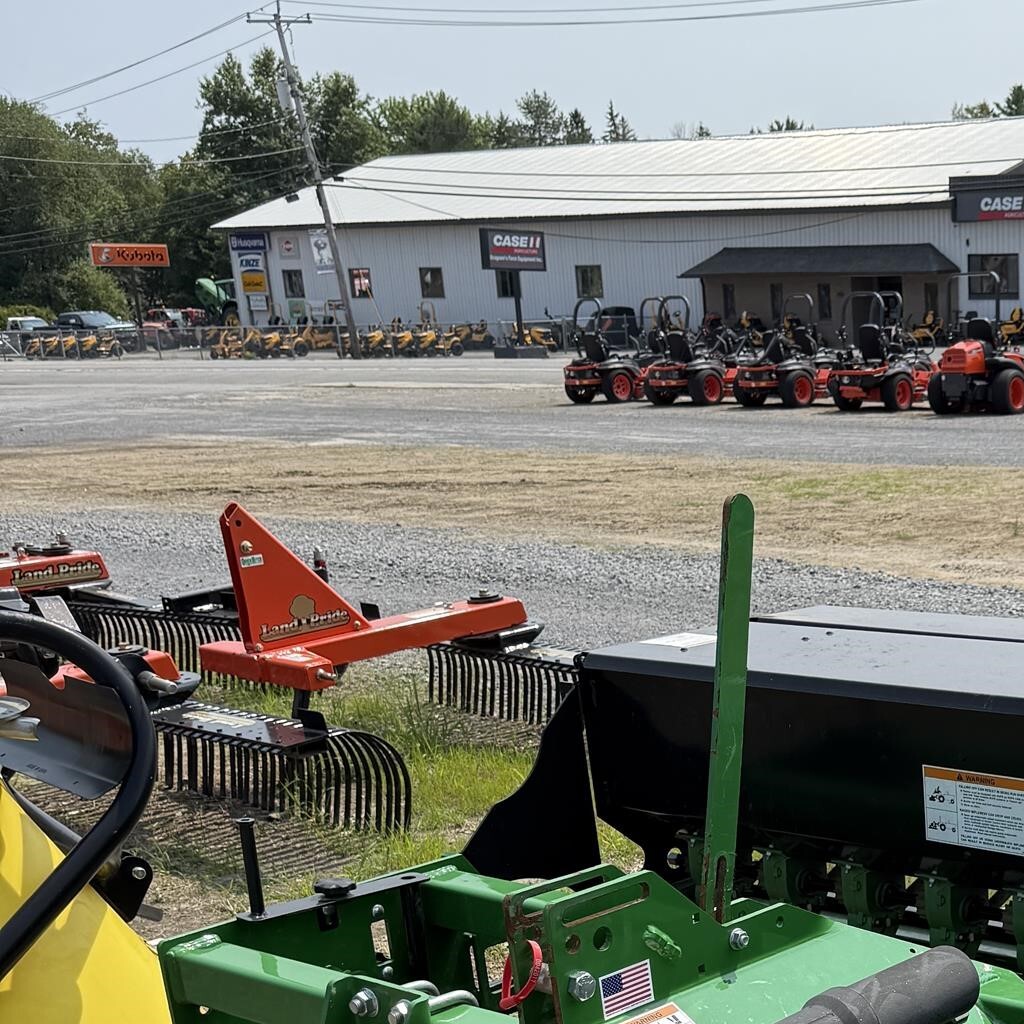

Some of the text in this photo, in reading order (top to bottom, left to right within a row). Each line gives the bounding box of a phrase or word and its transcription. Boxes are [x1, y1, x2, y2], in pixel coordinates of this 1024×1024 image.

[980, 196, 1023, 211] CASE
[493, 234, 528, 247] CASE
[116, 248, 165, 262] Kubota
[13, 560, 101, 580] Land Pride
[260, 609, 348, 635] Land Pride
[965, 774, 995, 785] WARNING
